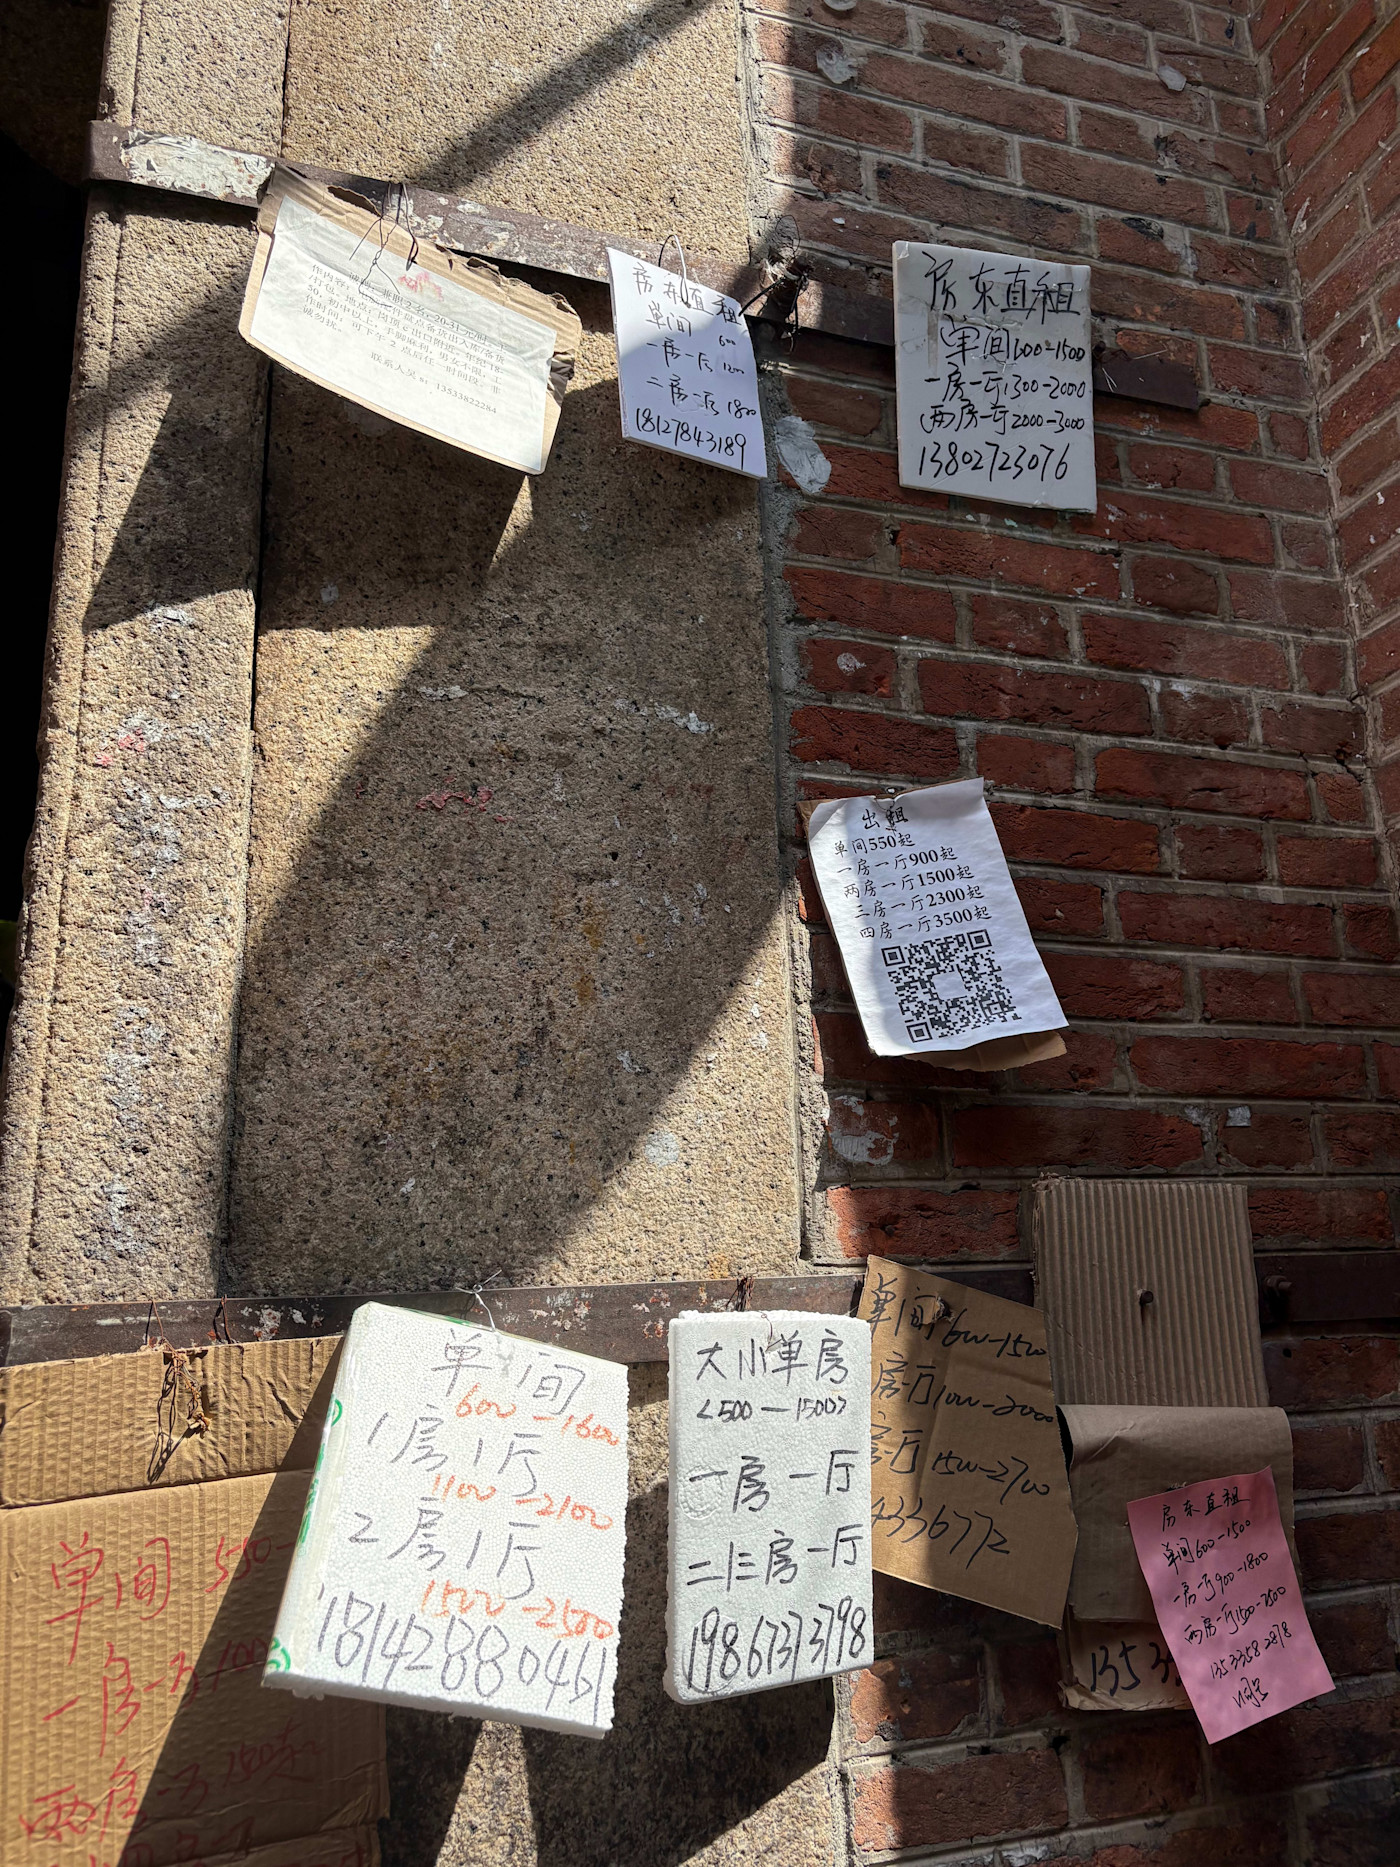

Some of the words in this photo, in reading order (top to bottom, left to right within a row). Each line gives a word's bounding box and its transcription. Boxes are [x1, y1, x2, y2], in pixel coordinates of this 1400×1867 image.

[922, 251, 1081, 325] 房东直租
[646, 301, 691, 337] 单间
[636, 408, 747, 470] 18127843189
[919, 441, 1069, 482] 13802723076
[862, 806, 908, 830] 出租
[834, 833, 916, 857] 单间550起
[837, 845, 958, 876] 一房一厅900起
[844, 864, 975, 898] 两房一厅1500起
[855, 884, 985, 919] 三房一厅2300起
[860, 904, 992, 939] 四房一厅3500起
[431, 1328, 586, 1416] 单间
[689, 1449, 859, 1513] 一房一厅
[1162, 1486, 1250, 1532] 房东直租
[46, 1531, 171, 1666] 单间
[317, 1590, 607, 1726] 18142880461
[687, 1596, 867, 1691] 19867373798
